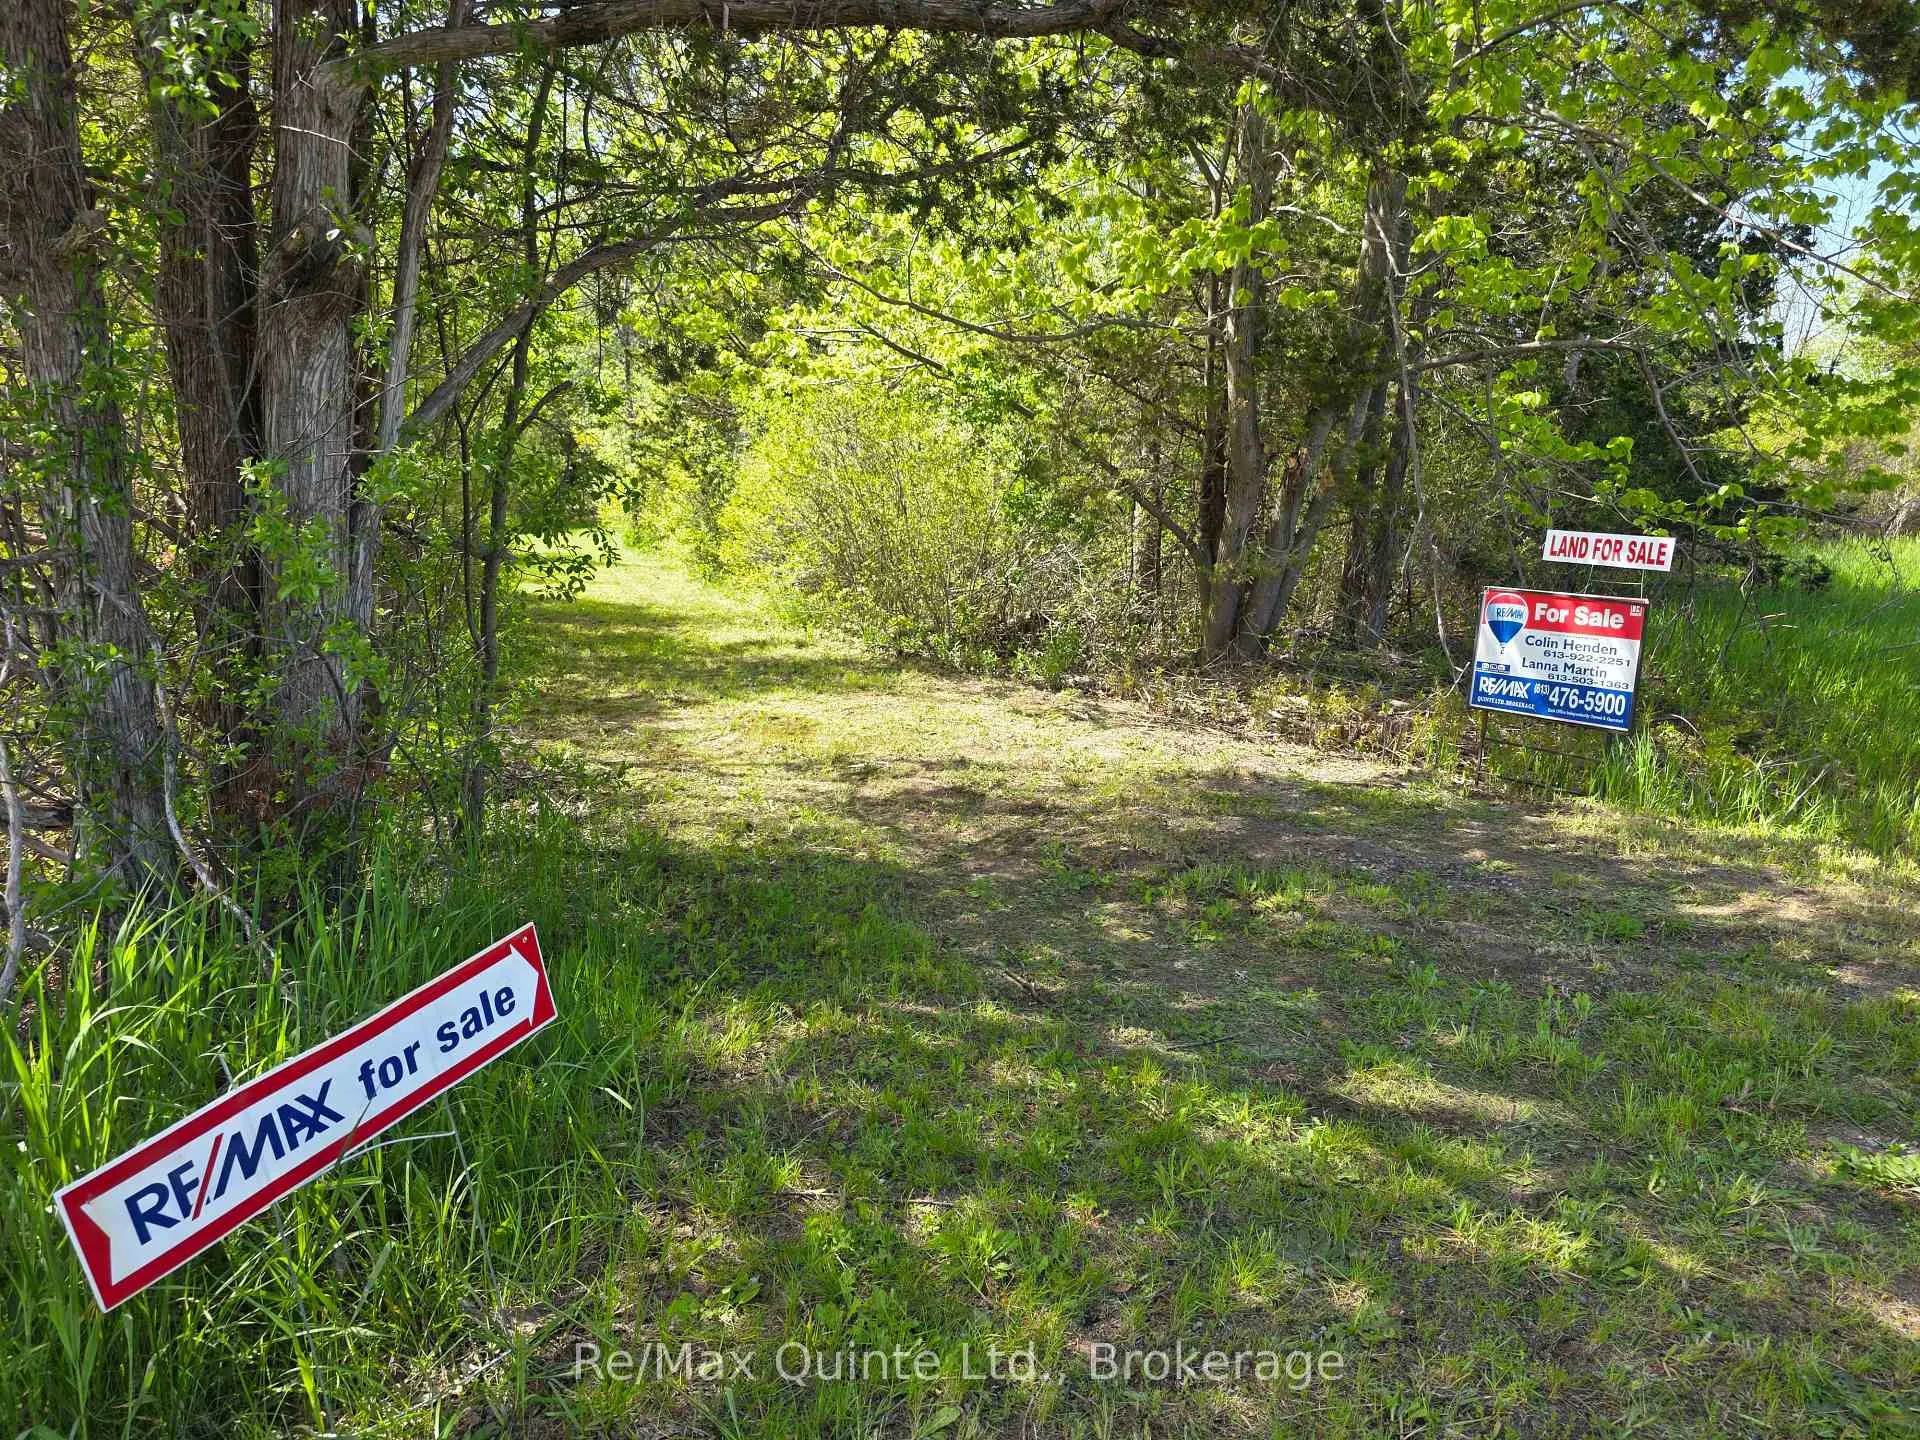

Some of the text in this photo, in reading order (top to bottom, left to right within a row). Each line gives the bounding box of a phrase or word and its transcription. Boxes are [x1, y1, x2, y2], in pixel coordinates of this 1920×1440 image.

[1549, 535, 1668, 565] LAND FOR SALE
[1496, 607, 1524, 620] RE/MAX
[1534, 603, 1569, 623] For
[1574, 606, 1624, 629] Sale
[1525, 635, 1559, 649] Colin
[1563, 639, 1617, 656] Henden
[1522, 657, 1558, 672] Lanna
[1563, 662, 1607, 679] Martin
[1543, 649, 1631, 667] 613-922-2251
[1478, 676, 1531, 699] RE/MAX
[1547, 673, 1630, 690] 613-503-1363
[1549, 686, 1626, 716] 476-5900
[124, 984, 517, 1246] RE/MAX for sale
